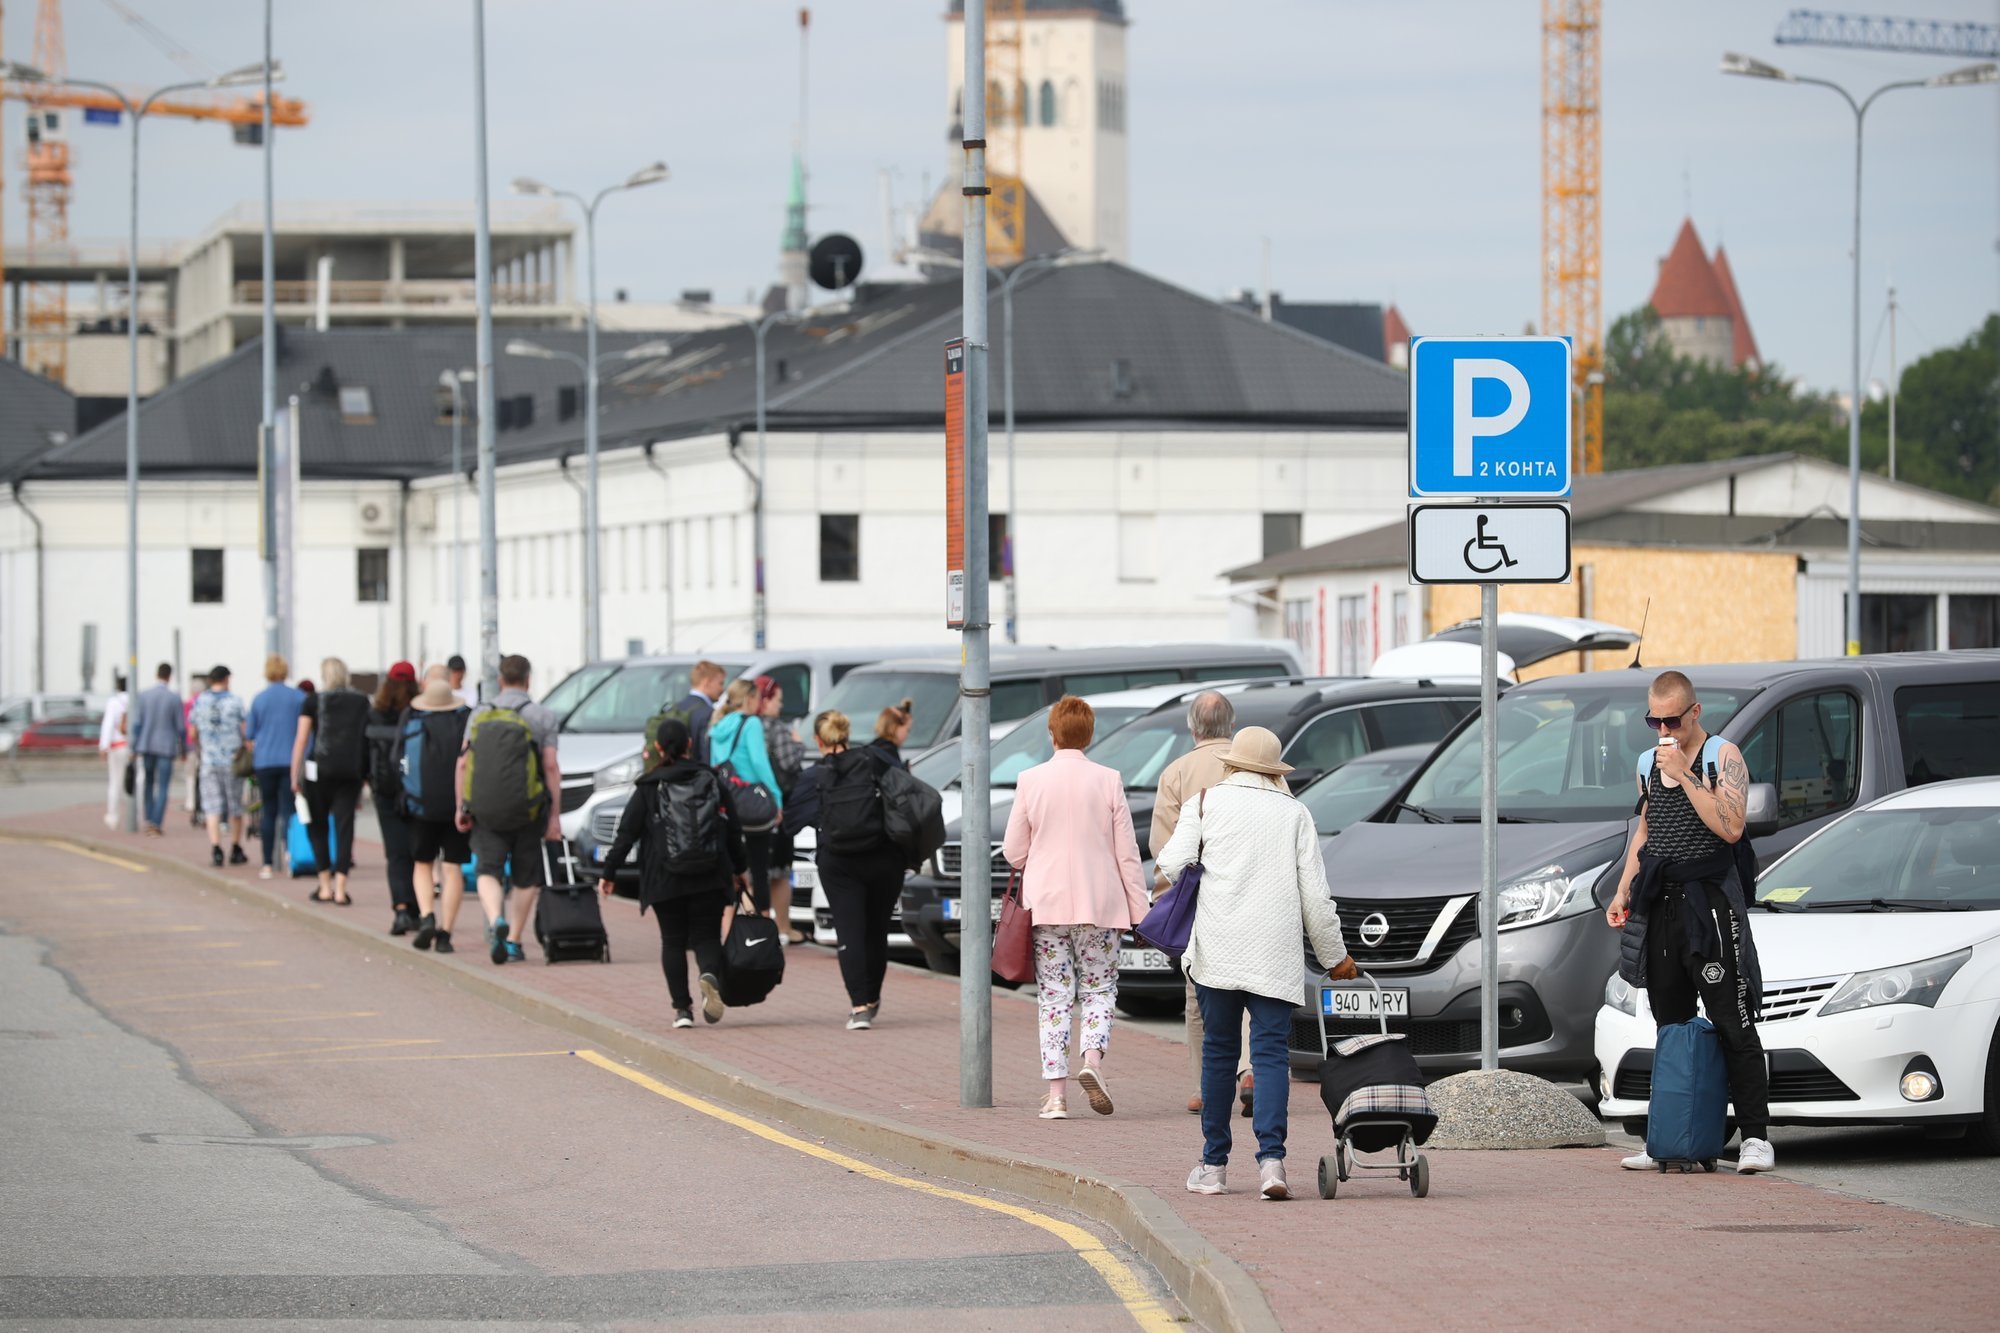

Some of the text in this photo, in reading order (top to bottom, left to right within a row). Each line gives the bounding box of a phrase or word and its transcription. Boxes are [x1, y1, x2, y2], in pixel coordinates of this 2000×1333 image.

[1453, 358, 1531, 477] P
[1479, 461, 1557, 477] 2 KOHTA
[1119, 952, 1134, 967] 04
[1335, 993, 1403, 1012] 940 MRY
